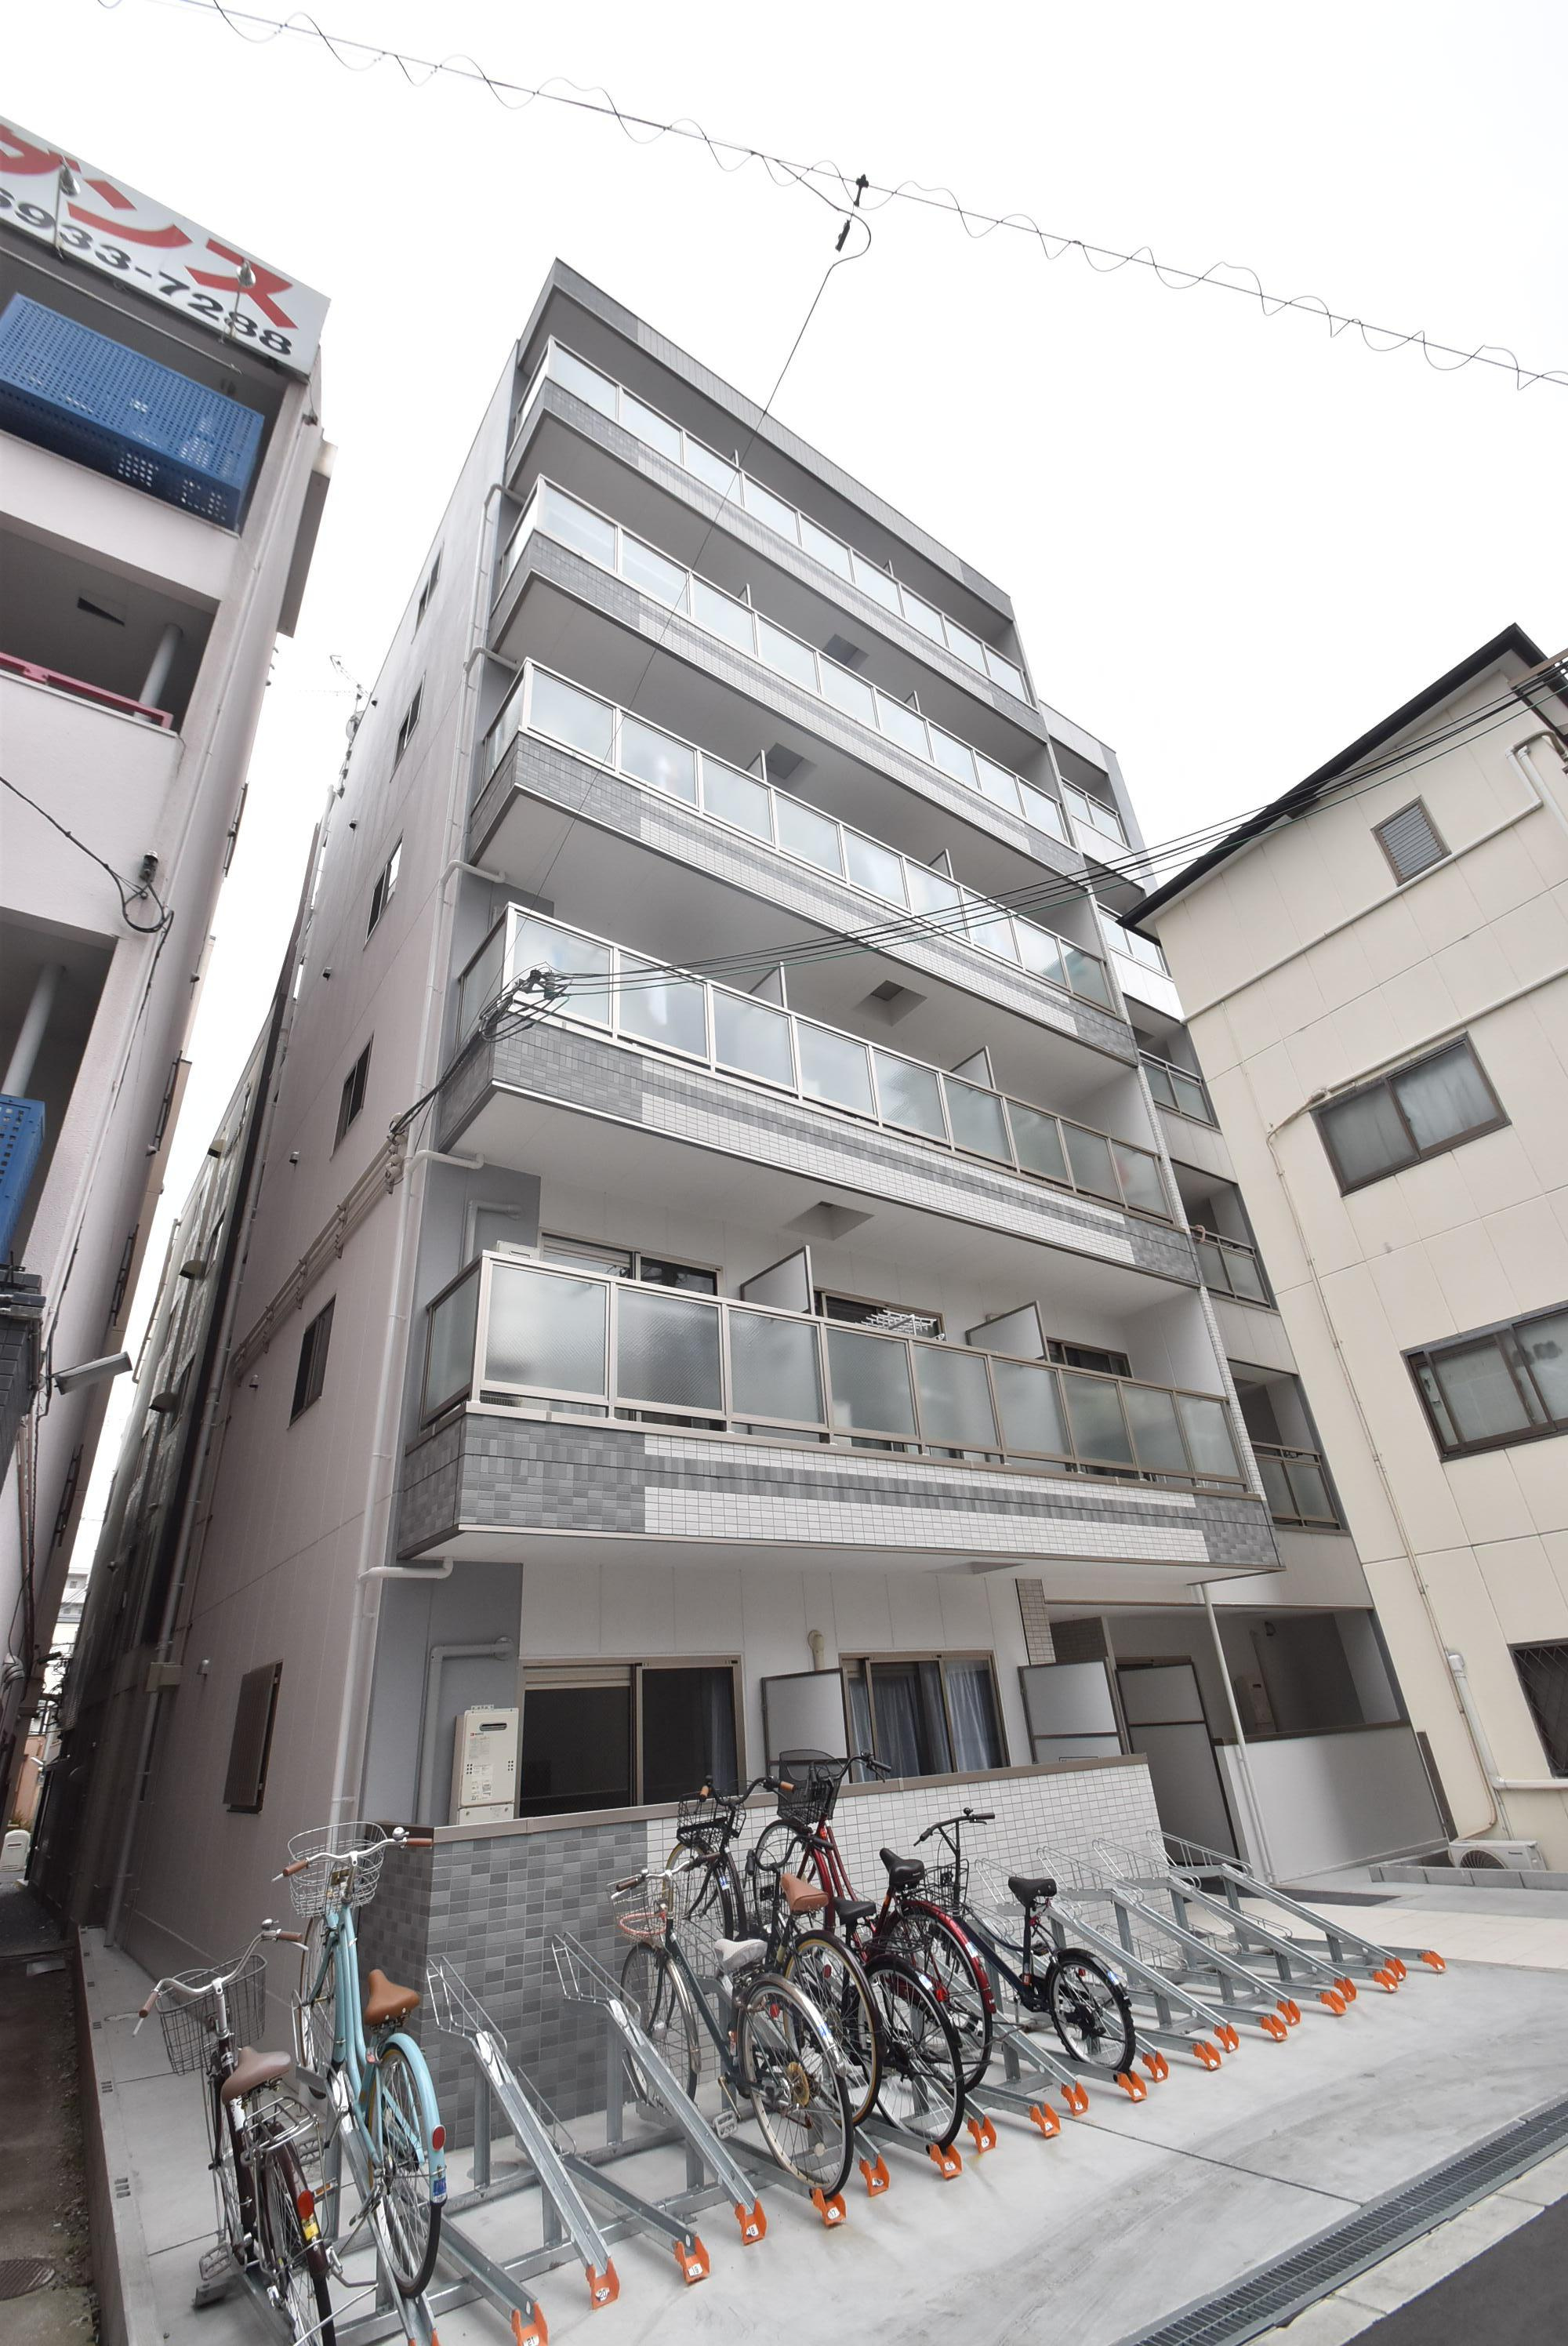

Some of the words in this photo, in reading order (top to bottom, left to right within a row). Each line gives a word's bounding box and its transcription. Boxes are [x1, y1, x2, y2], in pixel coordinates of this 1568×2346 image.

[691, 2266, 699, 2275] 19
[598, 2289, 607, 2298] 20
[526, 2336, 535, 2346] 21
